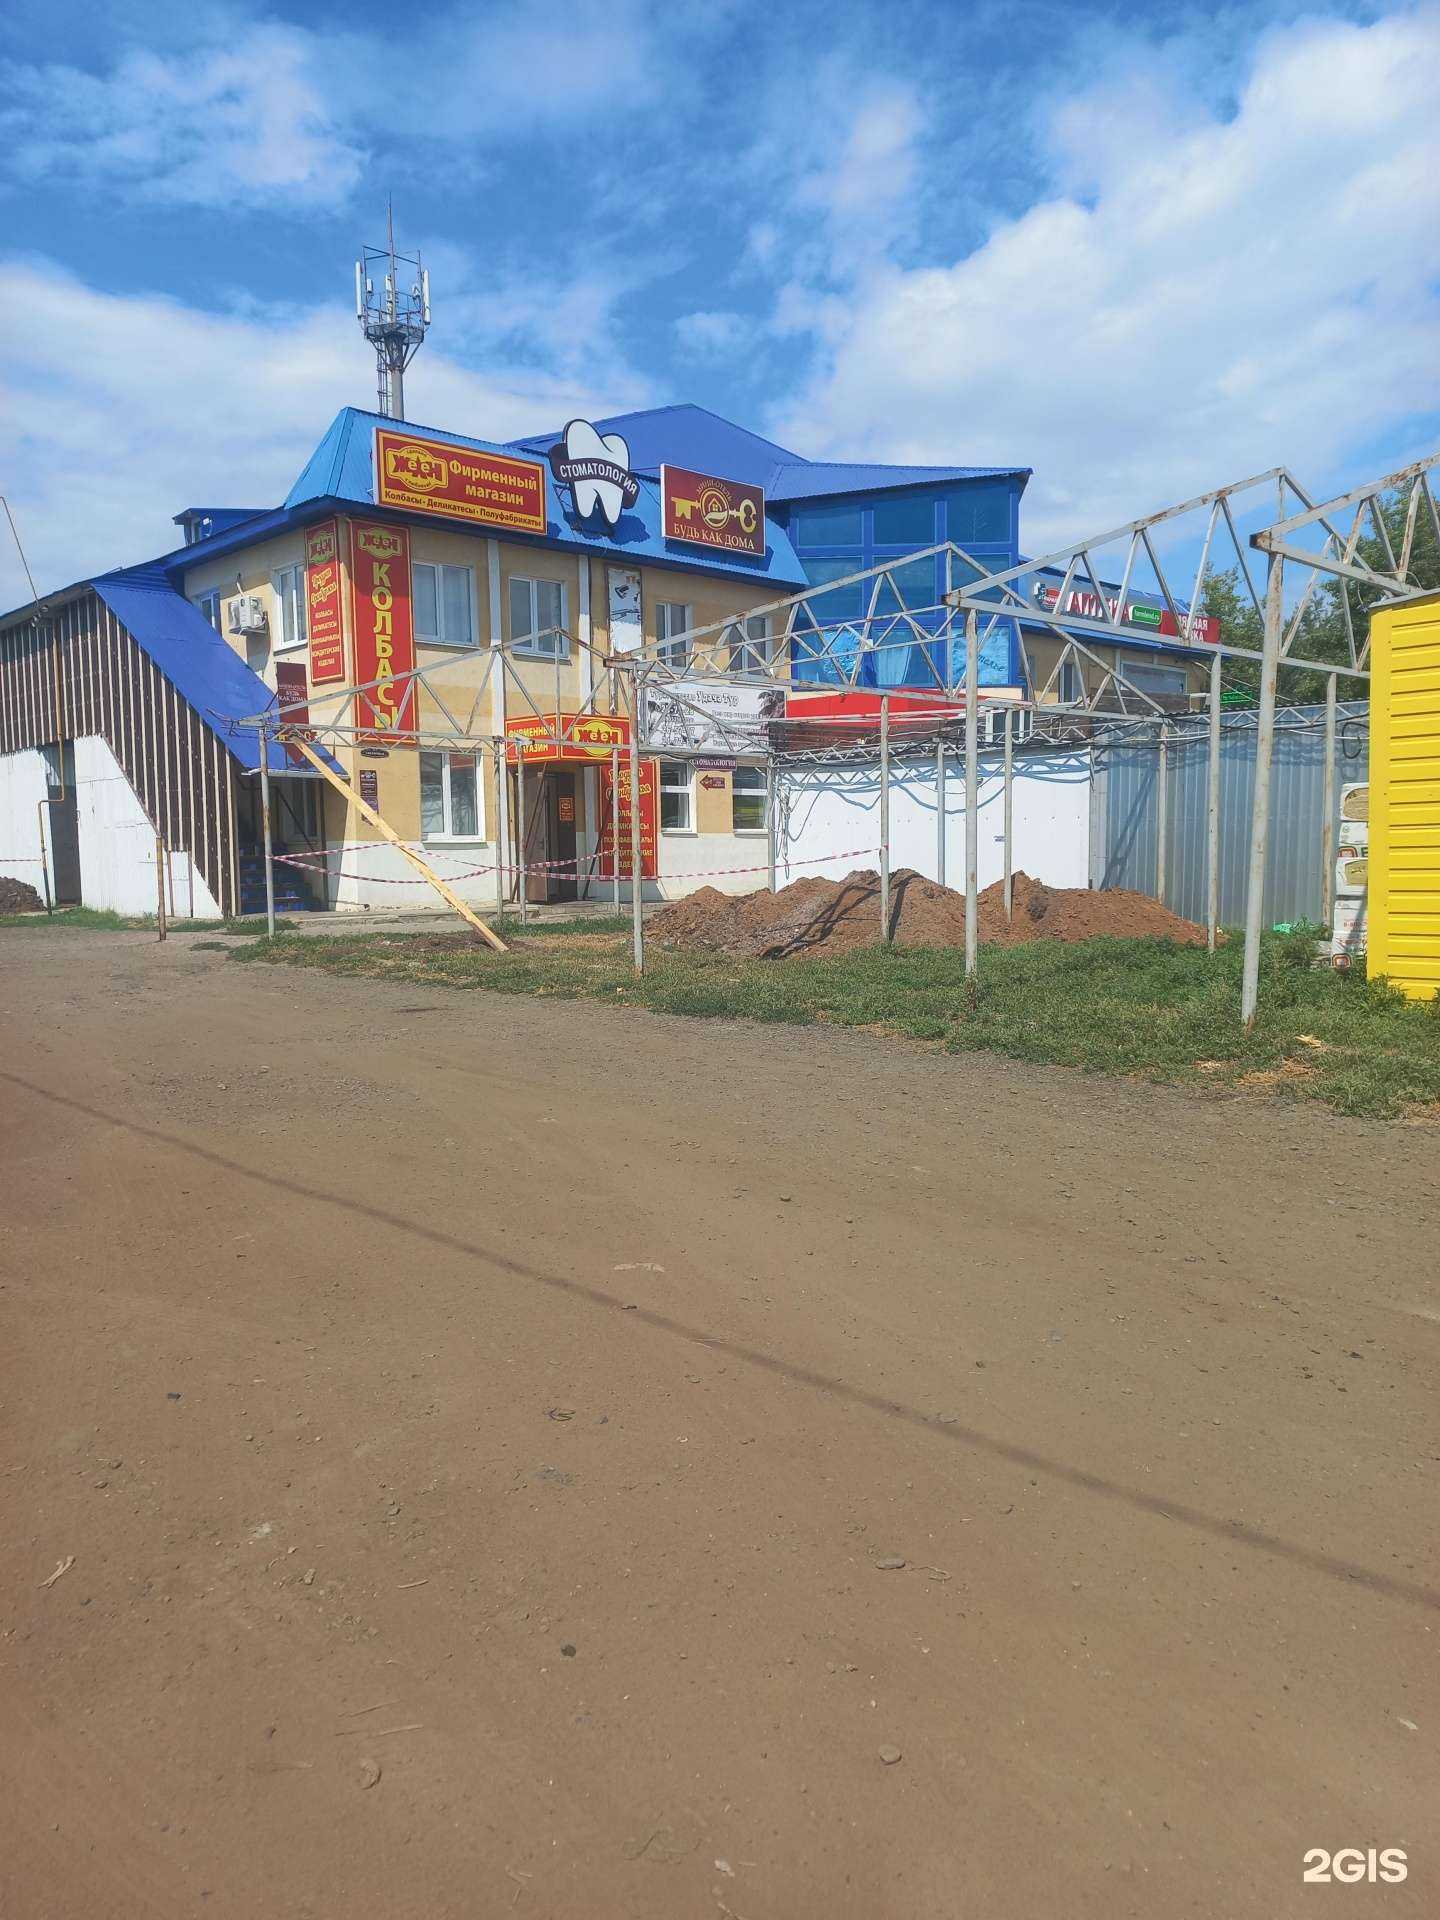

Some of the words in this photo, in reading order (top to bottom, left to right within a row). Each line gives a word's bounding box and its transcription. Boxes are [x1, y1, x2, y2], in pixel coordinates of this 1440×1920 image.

[449, 459, 537, 491] Фирменный
[559, 462, 638, 496] СТОМАТОЛОГИЯ
[384, 489, 422, 505] Колбасы
[426, 498, 476, 515] Деликатесы
[480, 508, 542, 527] Полуфабрикаты
[465, 484, 524, 506] магазин
[673, 524, 700, 540] БУДЬ
[701, 529, 723, 543] КАК
[724, 534, 755, 550] ДОМА
[371, 562, 400, 730] КОЛБАСЫ
